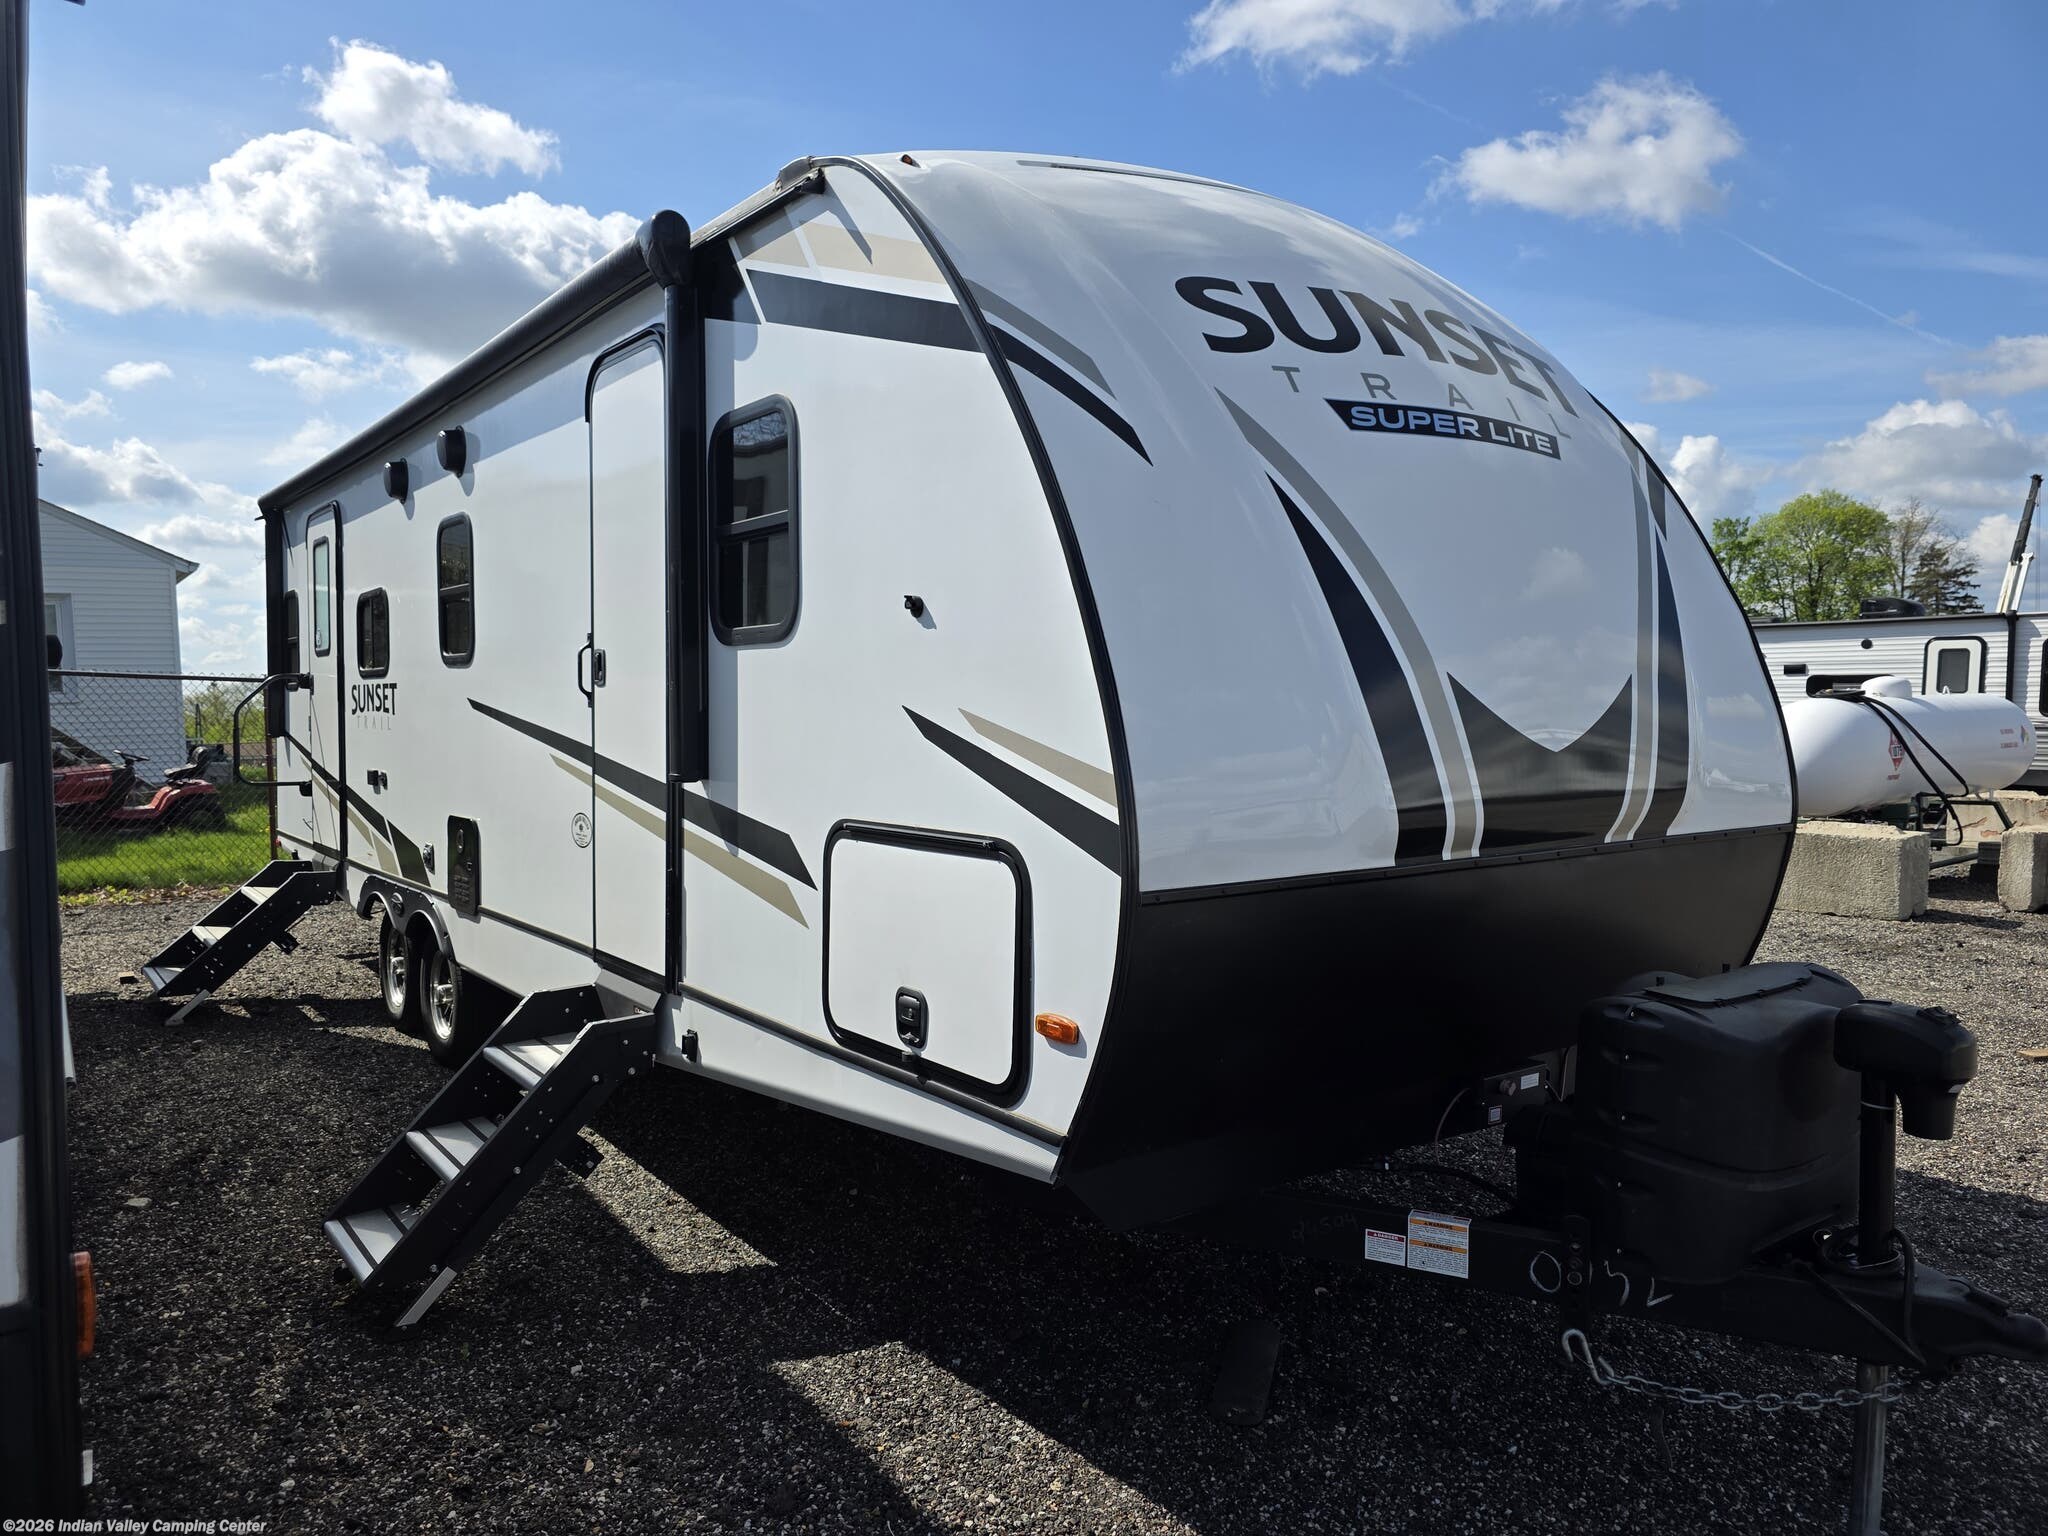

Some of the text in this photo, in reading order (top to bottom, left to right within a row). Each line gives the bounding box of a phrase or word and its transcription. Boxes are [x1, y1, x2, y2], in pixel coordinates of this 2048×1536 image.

[1174, 276, 1579, 418] SUNSET
[1271, 365, 1571, 440] TRAIL
[1350, 406, 1553, 454] SUPER LITE
[351, 683, 398, 715] SUNSET
[357, 715, 392, 731] TRAIL
